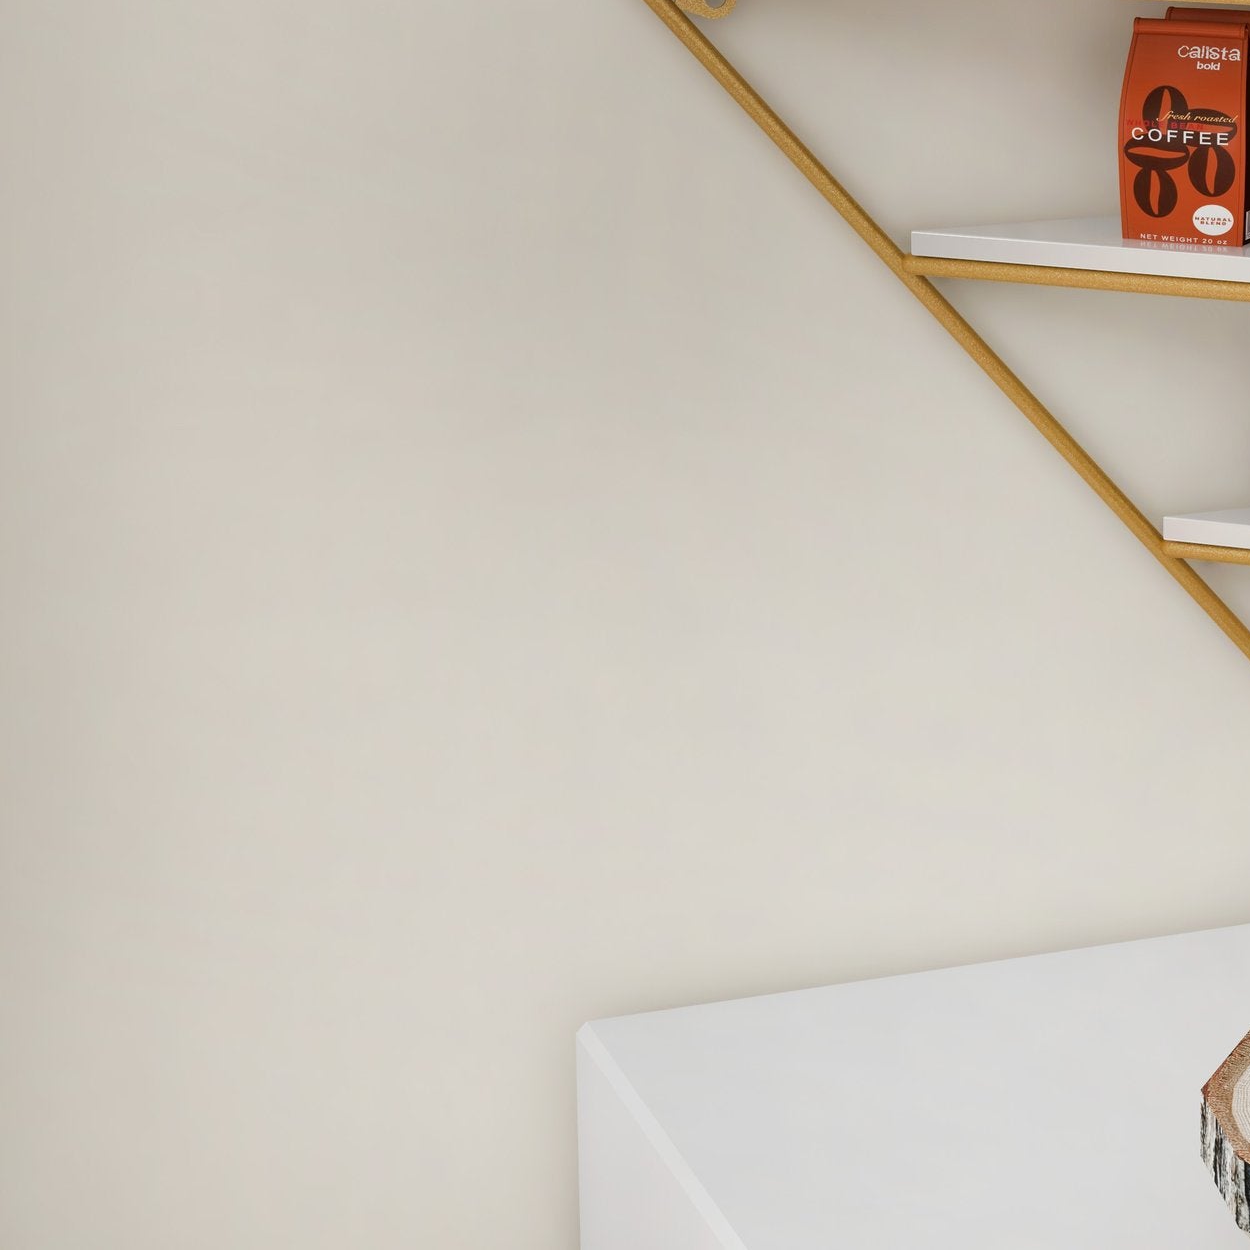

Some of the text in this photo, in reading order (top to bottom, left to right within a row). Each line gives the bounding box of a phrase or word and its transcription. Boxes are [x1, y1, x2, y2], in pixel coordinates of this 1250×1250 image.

[1196, 61, 1220, 71] bold
[1156, 110, 1239, 124] fresh roasted
[1131, 127, 1229, 146] COFFEE
[1161, 235, 1199, 243] WEIGHT
